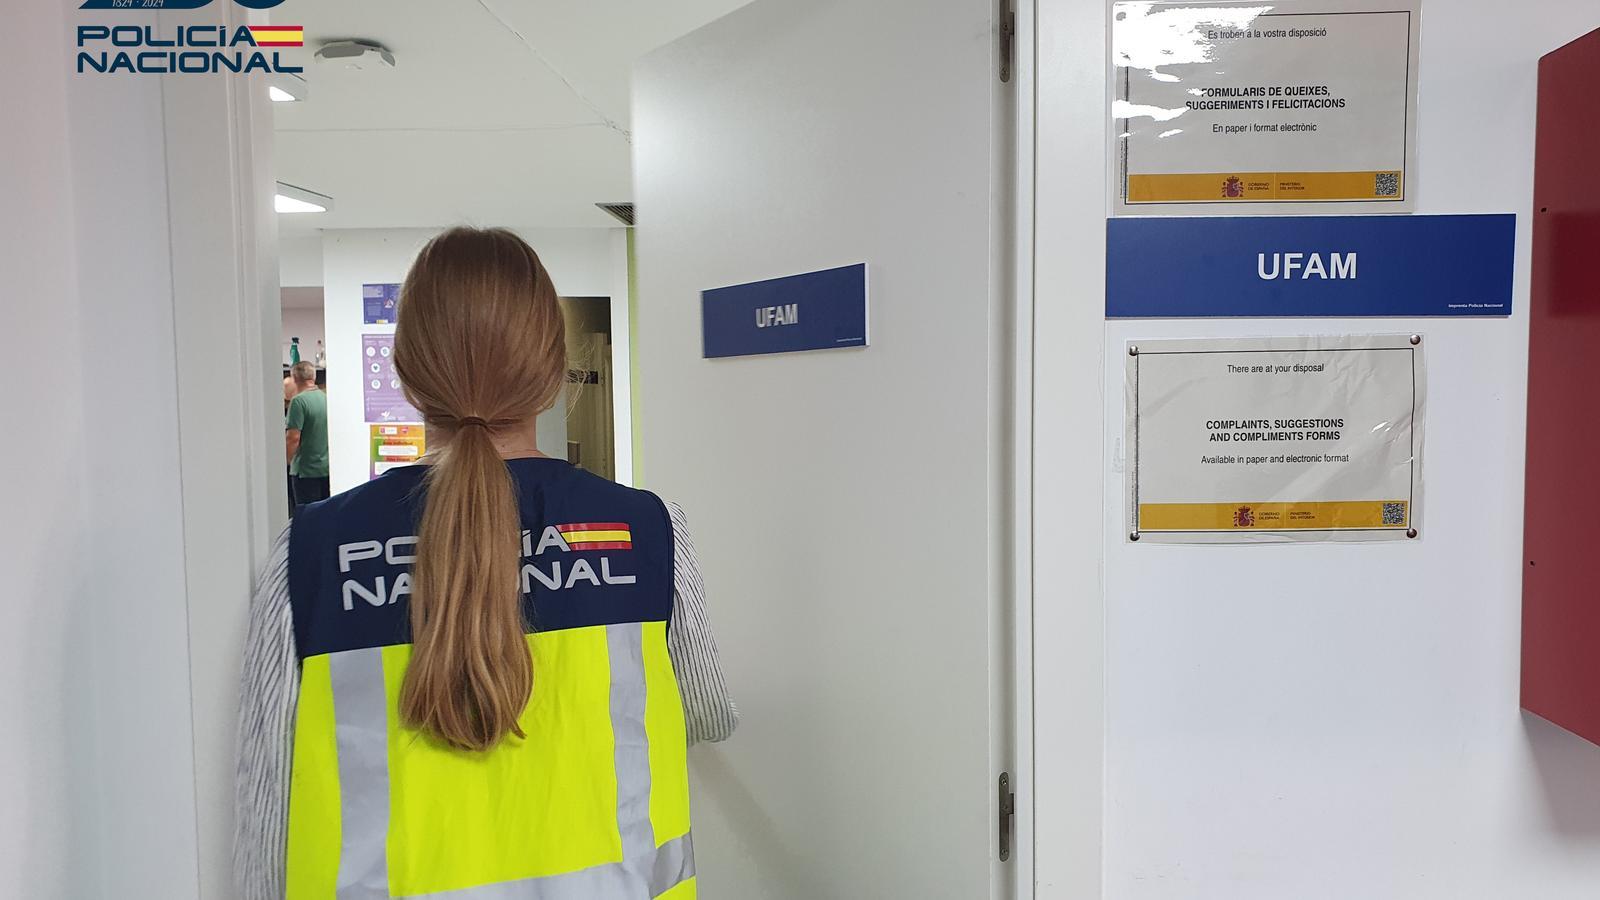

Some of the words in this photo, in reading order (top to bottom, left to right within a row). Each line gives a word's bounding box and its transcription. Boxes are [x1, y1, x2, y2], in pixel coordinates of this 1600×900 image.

[1208, 30, 1218, 39] Es
[1220, 29, 1245, 39] troben
[1254, 29, 1261, 38] la
[1263, 29, 1287, 38] vostra
[1288, 27, 1327, 39] disposició
[1201, 87, 1266, 97] FORMULARIS
[1268, 86, 1282, 96] DE
[1284, 86, 1331, 97] QUEIXES,
[1185, 100, 1264, 110] SUGGERIMENTS
[1266, 100, 1270, 109] I
[1271, 98, 1346, 109] FELICITACIONS
[1212, 123, 1224, 133] En
[1225, 124, 1248, 135] paper
[1253, 123, 1279, 132] format
[1280, 122, 1317, 132] electrònic
[1258, 252, 1357, 280] UFAM
[755, 303, 798, 328] UFAM
[1227, 364, 1249, 373] There
[1251, 365, 1263, 373] are
[1265, 364, 1273, 373] at
[1274, 365, 1291, 375] your
[1292, 363, 1325, 374] disposal
[1206, 419, 1272, 430] COMPLAINTS,
[1274, 418, 1344, 429] SUGGESTIONS
[1209, 432, 1231, 442] AND
[1233, 431, 1304, 441] COMPLIMENTS
[1306, 431, 1341, 441] FORMS
[1201, 455, 1235, 464] Available
[1237, 455, 1244, 464] in
[1246, 456, 1268, 465] paper
[1269, 454, 1284, 463] and
[1286, 454, 1322, 463] electronic
[1323, 453, 1350, 463] format
[338, 525, 571, 573] POÍA
[342, 556, 637, 611] NANAL
